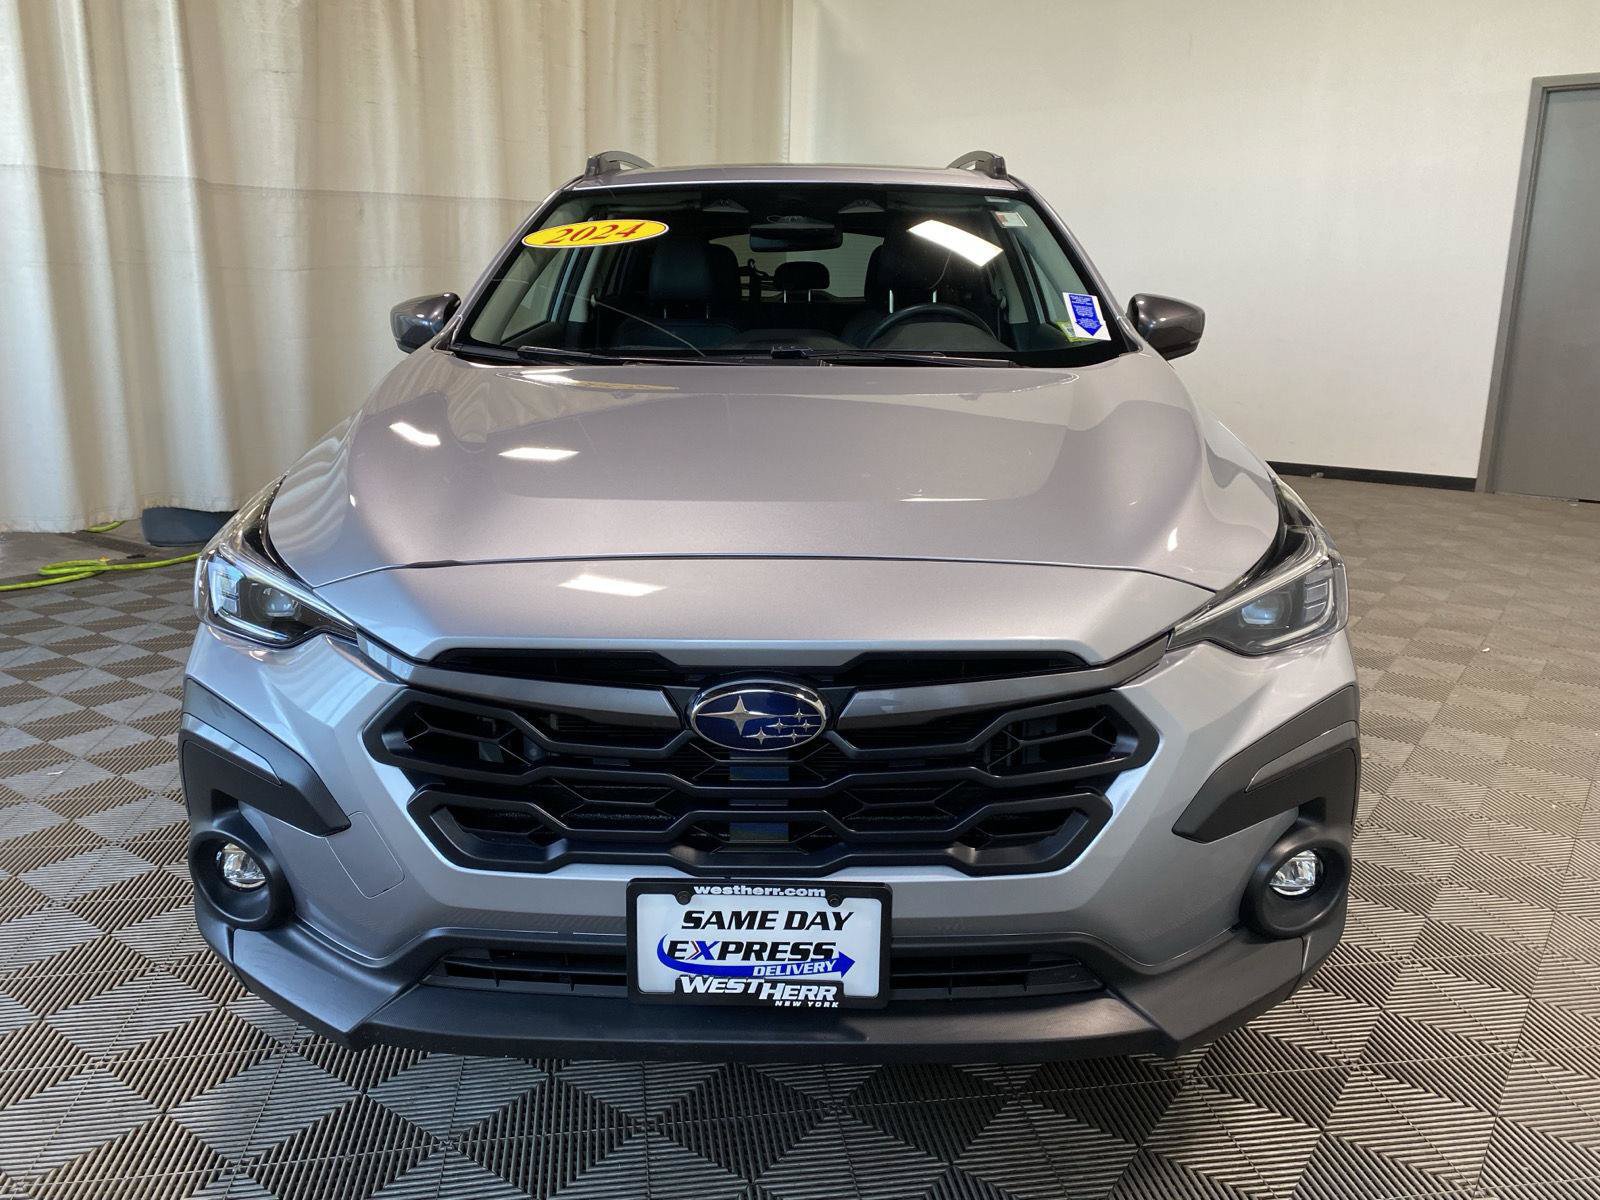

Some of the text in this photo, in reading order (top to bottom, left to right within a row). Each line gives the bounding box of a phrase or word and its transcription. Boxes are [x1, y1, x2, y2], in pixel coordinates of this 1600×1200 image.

[543, 222, 646, 244] 2024
[694, 885, 826, 897] westherr.com
[681, 910, 855, 931] SAME DAY
[666, 940, 837, 962] EXPRESS
[752, 961, 837, 977] DELIVERY
